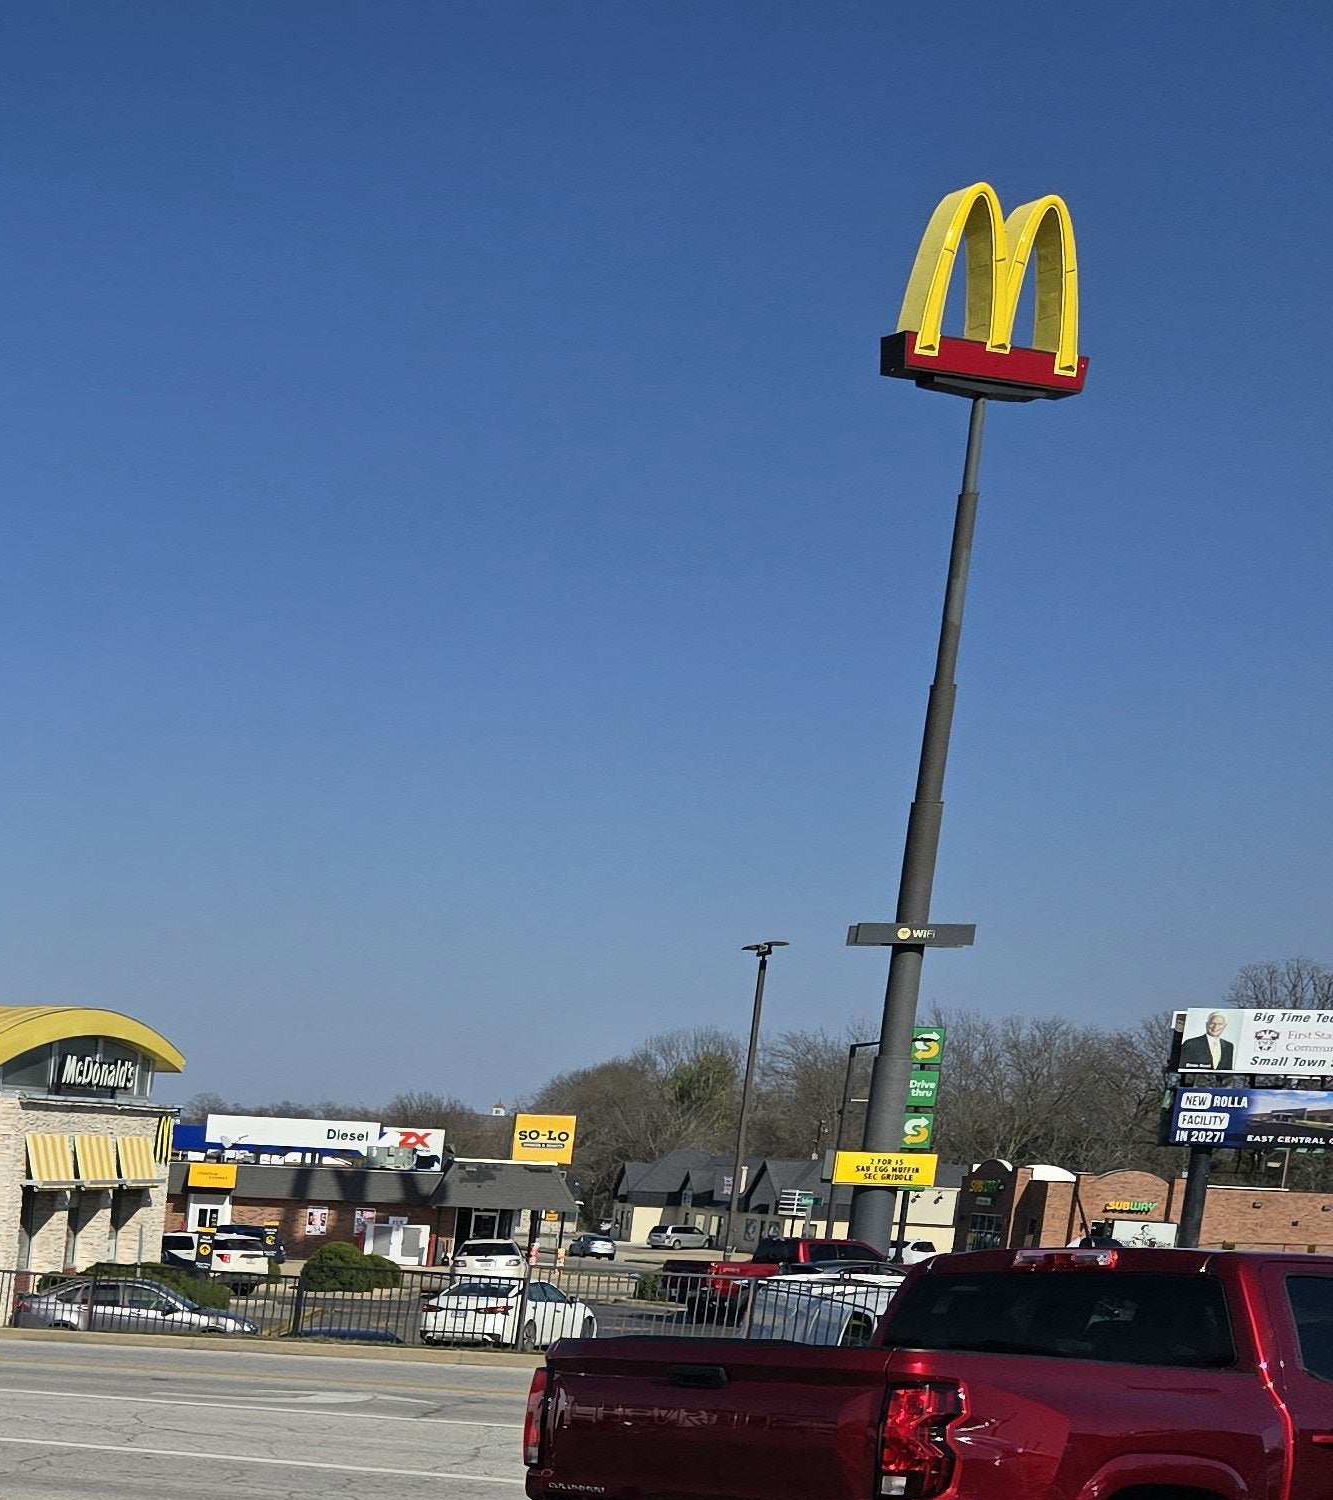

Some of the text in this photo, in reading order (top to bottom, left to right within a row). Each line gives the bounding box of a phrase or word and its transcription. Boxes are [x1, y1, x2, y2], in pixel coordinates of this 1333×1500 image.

[1253, 1012, 1275, 1024] Big
[1280, 1012, 1312, 1023] Time
[1249, 1056, 1289, 1067] Small
[1293, 1057, 1327, 1067] Town
[61, 1054, 135, 1088] McDonald's
[909, 1080, 936, 1090] Drive
[910, 1089, 933, 1098] thru
[1185, 1095, 1248, 1108] NEW ROLLA
[1181, 1114, 1225, 1126] FACILITY
[326, 1128, 369, 1142] Diesel
[518, 1129, 570, 1142] SO-LO
[1175, 1129, 1189, 1142] IN
[1246, 1134, 1275, 1143] EAST
[1277, 1135, 1326, 1145] CENTRAL
[874, 1165, 889, 1173] EGG
[891, 1166, 920, 1174] MUFFIN
[1105, 1200, 1159, 1212] SUBWAY
